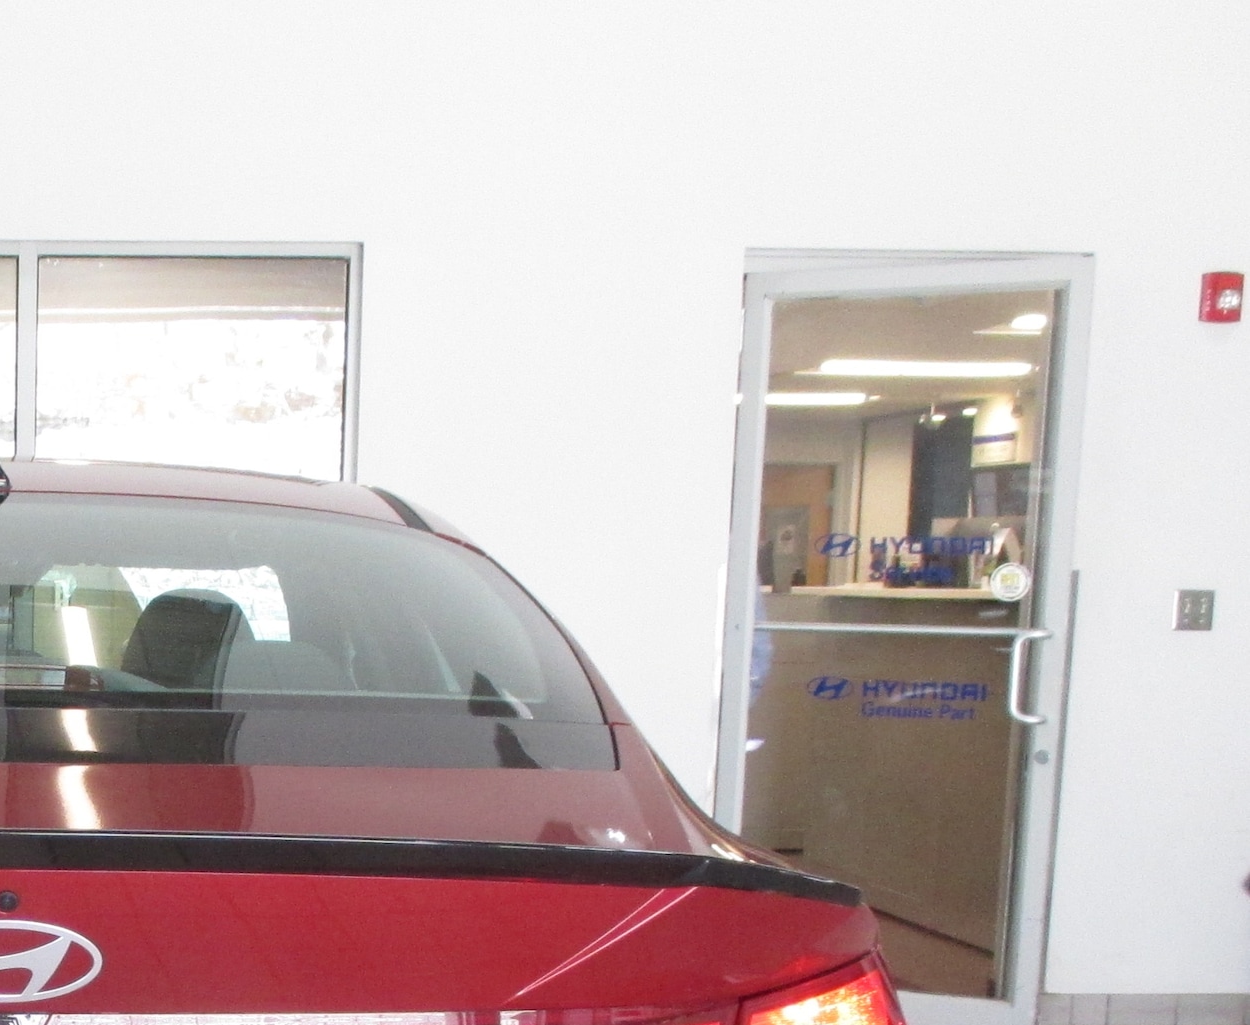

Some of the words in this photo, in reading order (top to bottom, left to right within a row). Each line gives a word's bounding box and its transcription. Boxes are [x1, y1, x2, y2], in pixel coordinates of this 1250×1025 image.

[870, 536, 993, 555] HYUNDAI
[862, 680, 987, 701] HYUNDAI
[861, 701, 933, 718] Genuine
